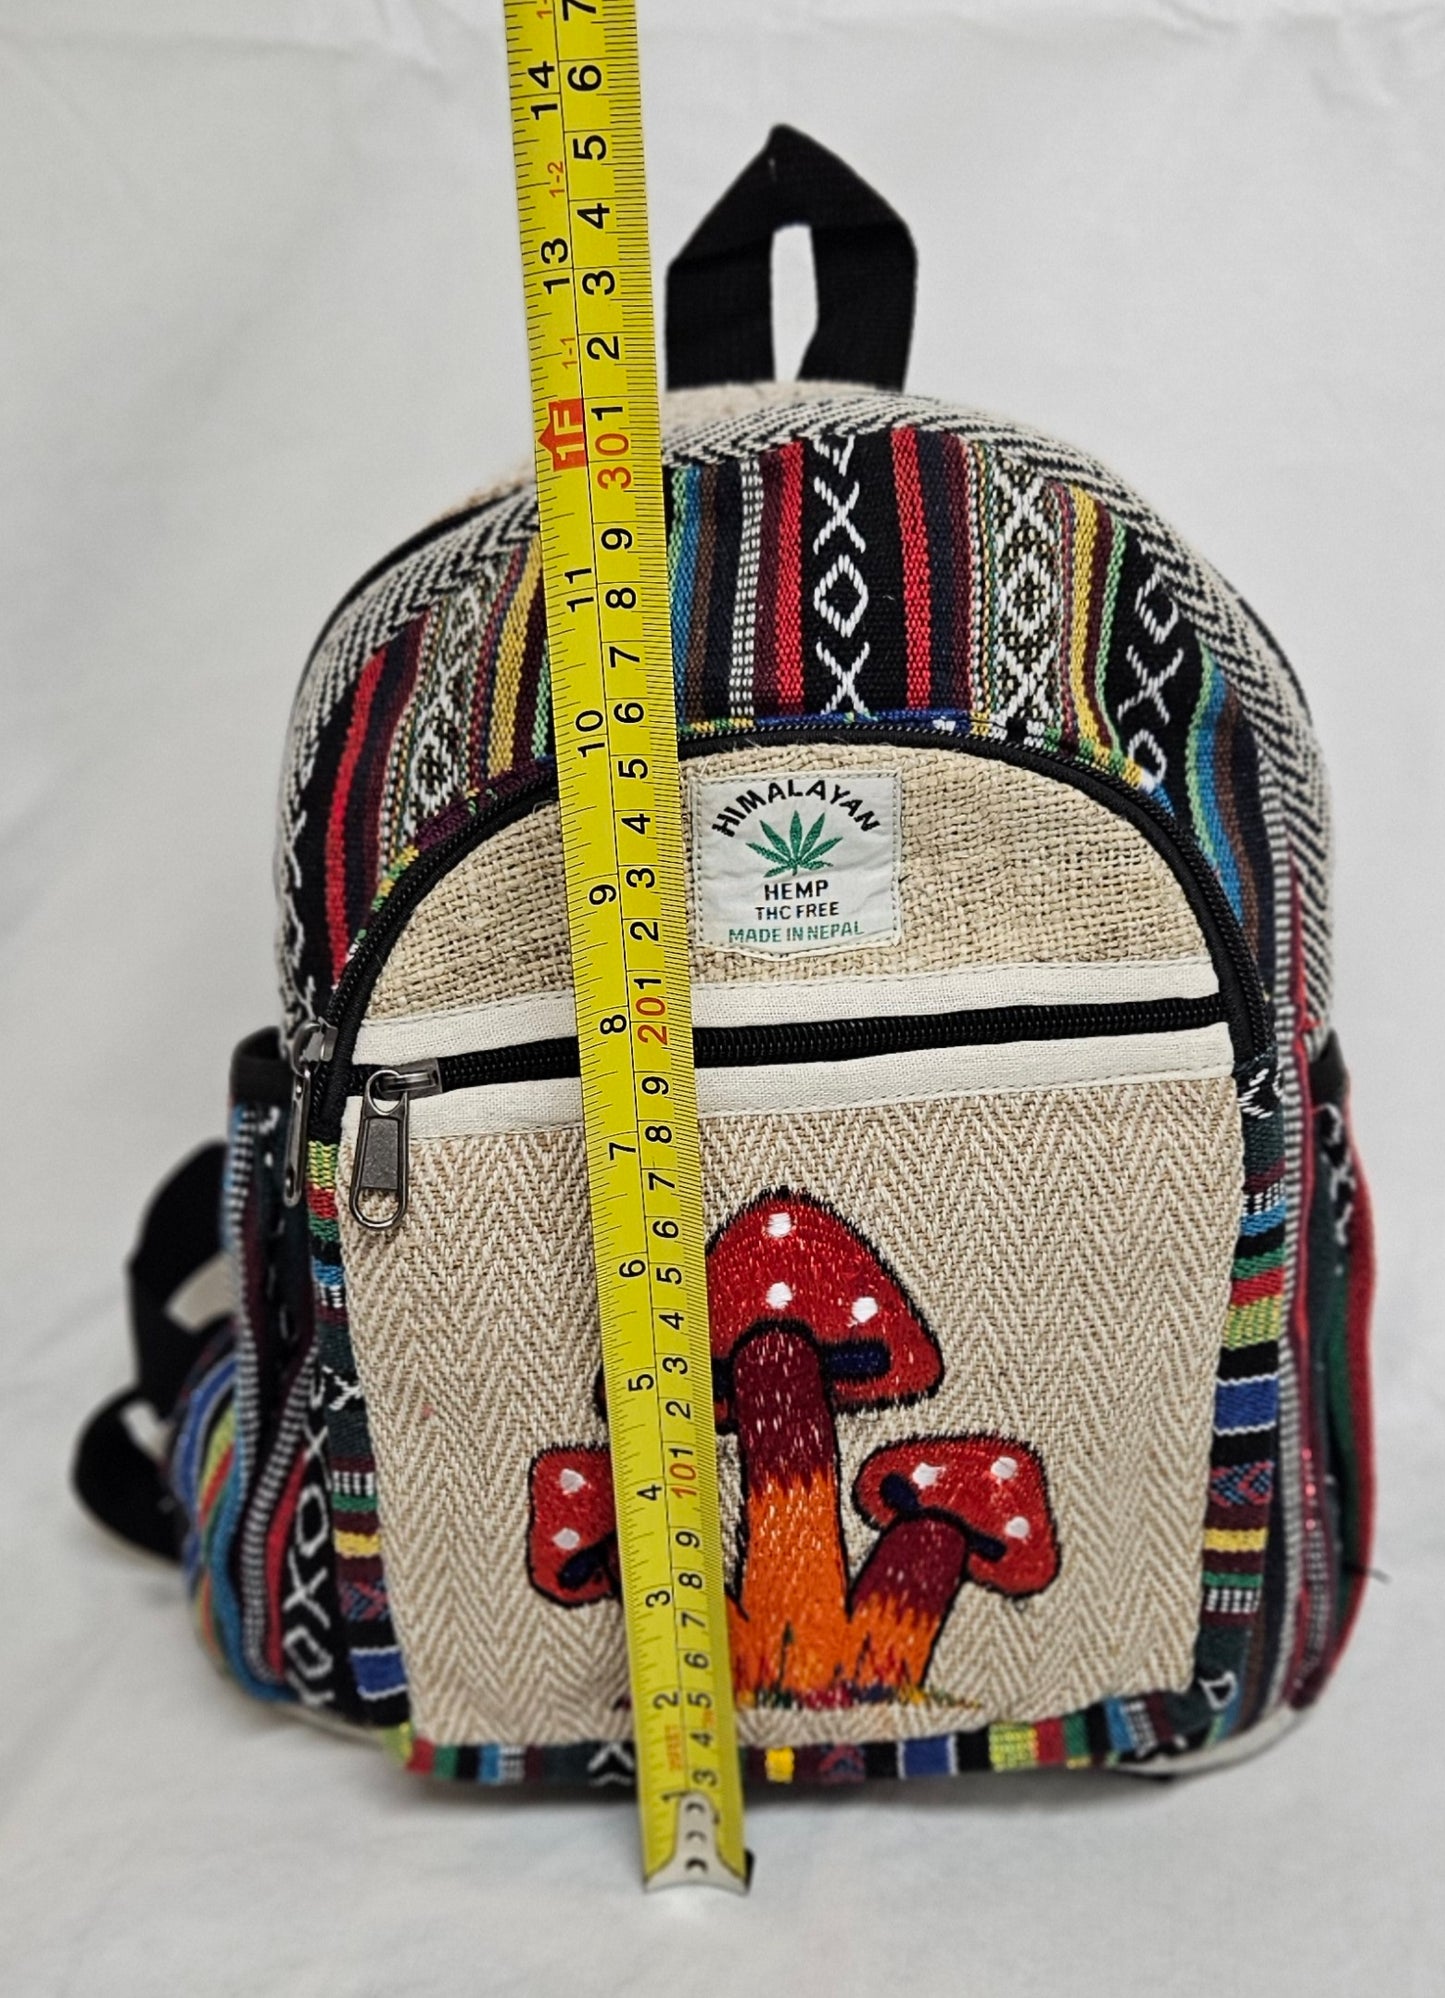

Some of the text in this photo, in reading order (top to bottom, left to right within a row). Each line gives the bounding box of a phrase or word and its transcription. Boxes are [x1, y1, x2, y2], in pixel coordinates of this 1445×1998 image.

[562, 0, 597, 21] 7
[567, 64, 602, 92] 6
[527, 60, 558, 120] 14
[572, 134, 607, 161] 5
[547, 161, 565, 198] 1-2
[577, 202, 610, 229] 4
[540, 238, 570, 294] 13
[582, 270, 615, 295] 3
[560, 337, 578, 370] 1-1
[586, 335, 620, 360] 2
[591, 406, 623, 421] 1
[553, 410, 585, 461] 1F
[595, 433, 632, 490] 30
[601, 527, 633, 551] 9
[565, 567, 595, 612] 11
[605, 587, 636, 610] 8
[608, 645, 640, 668] 7
[614, 702, 645, 724] 6
[575, 710, 605, 758] 10
[618, 758, 649, 780] 5
[711, 779, 881, 838] HIMALAYAN
[621, 813, 651, 835] 4
[626, 867, 655, 889] 3
[589, 884, 617, 905] 9
[764, 879, 829, 901] HEMP
[755, 901, 840, 921] THC FREE
[630, 921, 659, 942] 2
[728, 920, 864, 944] MADE IN NEPAL
[633, 978, 662, 990] 1
[600, 1014, 627, 1035] 8
[635, 997, 668, 1046] 20
[641, 1076, 669, 1095] 9
[645, 1125, 673, 1144] 8
[609, 1142, 636, 1161] 7
[648, 1171, 675, 1191] 7
[652, 1220, 679, 1239] 6
[619, 1259, 646, 1278] 6
[656, 1267, 682, 1285] 5
[658, 1312, 685, 1330] 4
[662, 1356, 688, 1375] 3
[628, 1373, 654, 1392] 5
[665, 1400, 691, 1420] 2
[669, 1463, 697, 1499] 10
[636, 1484, 662, 1501] 4
[675, 1531, 700, 1549] 9
[678, 1572, 703, 1590] 8
[645, 1590, 671, 1608] 3
[681, 1611, 706, 1628] 7
[684, 1652, 709, 1670] 6
[652, 1691, 679, 1710] 2
[687, 1692, 712, 1709] 5
[690, 1731, 713, 1748] 4
[692, 1769, 718, 1787] 3
